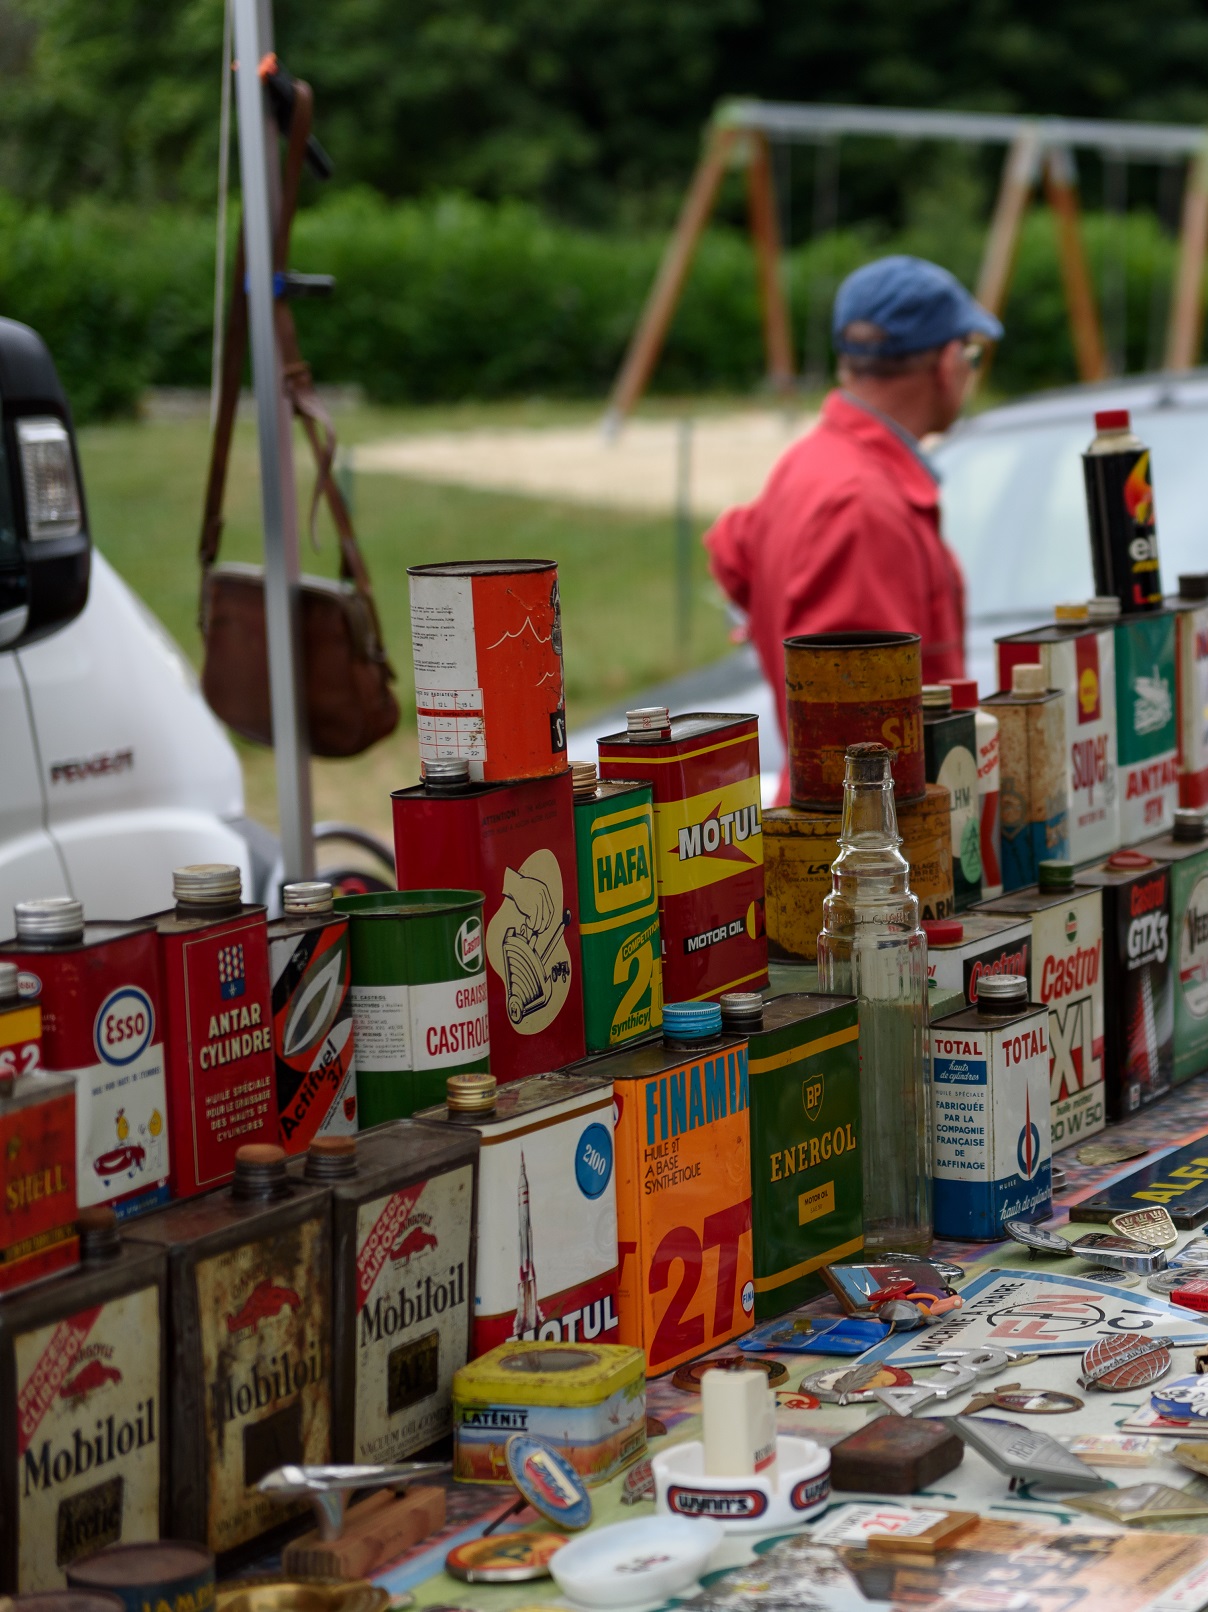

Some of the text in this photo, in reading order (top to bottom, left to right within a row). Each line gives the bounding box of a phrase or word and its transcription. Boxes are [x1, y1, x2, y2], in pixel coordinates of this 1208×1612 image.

[678, 803, 762, 861] MOTUL
[597, 844, 649, 893] HAFA
[687, 919, 744, 953] MOTOR OIL
[1040, 938, 1101, 1004] Castrol
[207, 1002, 262, 1039] ANTAR
[200, 1026, 272, 1070] CYLINDRE
[935, 1039, 983, 1056] TOTAL
[1001, 1026, 1048, 1067] TOTAL
[1049, 994, 1103, 1104] XL
[326, 1055, 344, 1091] 37
[940, 1072, 980, 1085] de cylindres
[948, 1060, 969, 1072] hauts
[204, 1075, 271, 1105] HUILE SPÉCIALE
[280, 1037, 338, 1141] Actifuel
[805, 1083, 822, 1110] BP
[935, 1089, 985, 1098] HUILE SPÉCIALE
[206, 1105, 226, 1118] POUR
[210, 1103, 269, 1131] DES HAUTS DE
[936, 1100, 985, 1112] FABRIQUÉE
[944, 1115, 974, 1124] PAR LA
[216, 1118, 264, 1142] CYLINDRES
[936, 1124, 985, 1135] COMPAGNIE
[1066, 1114, 1083, 1136] W
[644, 1142, 670, 1163] HUILE
[770, 1123, 857, 1184] ENERGOL
[936, 1136, 985, 1148] FRANÇAISE
[954, 1149, 965, 1158] DE
[582, 1143, 607, 1176] 2100
[645, 1155, 679, 1179] A BASE
[936, 1159, 986, 1170] RAFFINAGE
[6, 1165, 68, 1205] SHELL
[804, 1189, 829, 1207] MOTOR OIL
[999, 1179, 1017, 1190] HUILE
[1000, 1198, 1022, 1221] hauts
[649, 1195, 753, 1368] 2T
[359, 1262, 465, 1348] Mobiloil
[911, 1317, 976, 1351] MACHINE
[976, 1282, 1026, 1309] TRAIRE
[23, 1397, 156, 1498] Mobiloil
